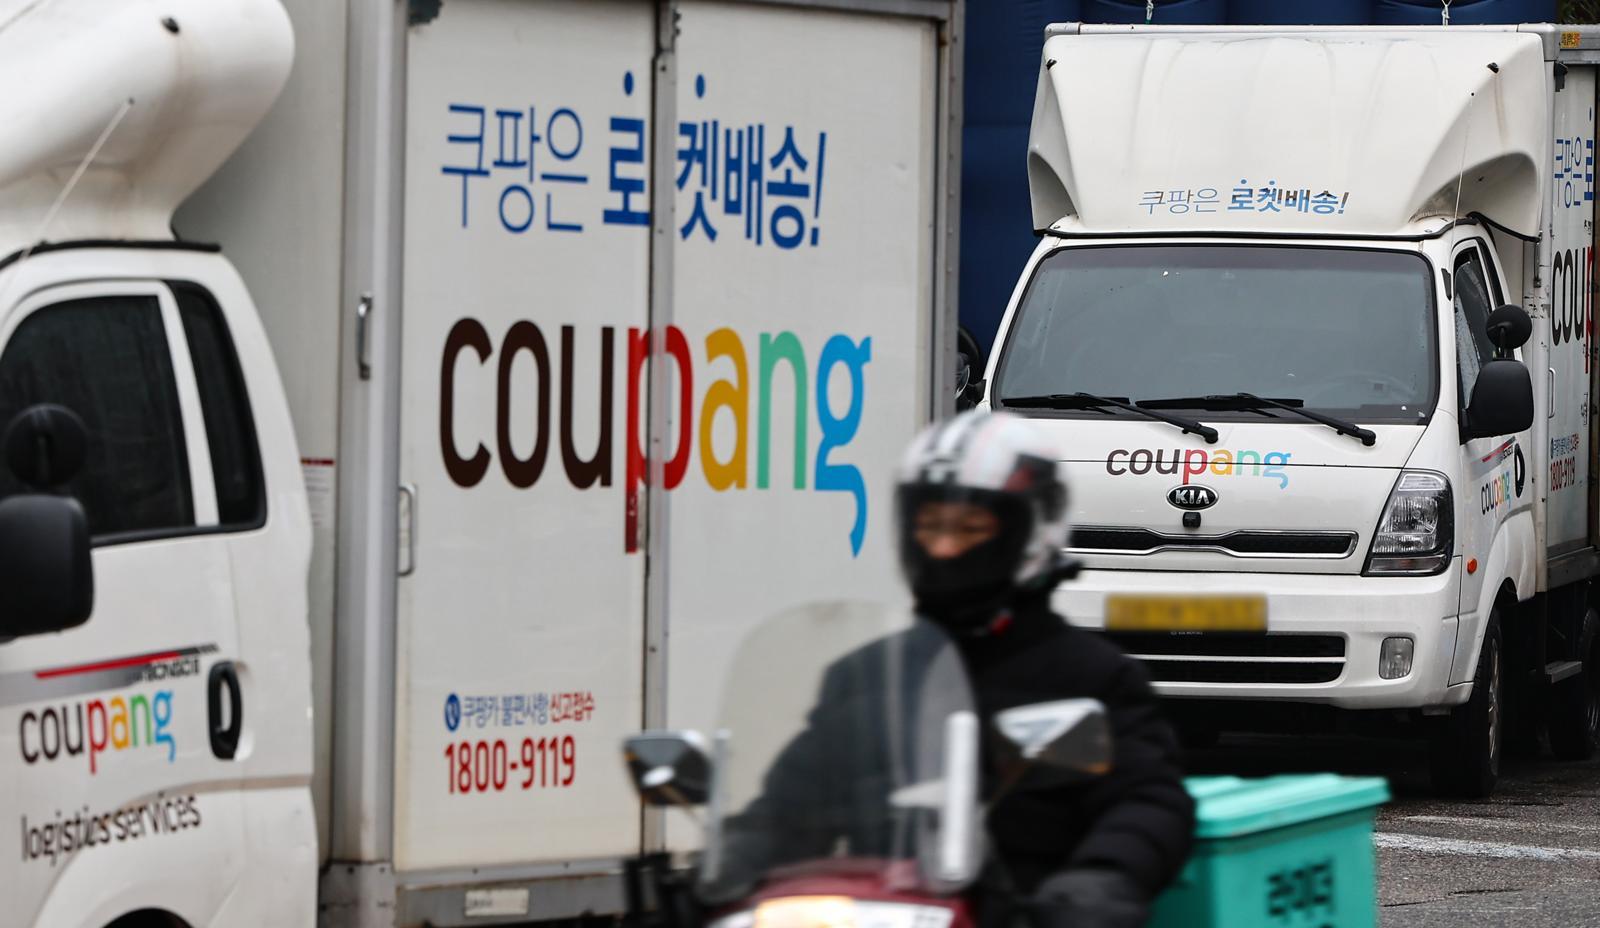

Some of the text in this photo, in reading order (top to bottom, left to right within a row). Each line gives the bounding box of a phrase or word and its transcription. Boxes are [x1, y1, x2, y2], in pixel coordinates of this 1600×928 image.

[442, 104, 826, 249] 쿠팡은 로켓배송!
[1138, 187, 1350, 214] 쿠팡은 로켓배송!
[1554, 136, 1582, 208] 쿠팡은
[440, 317, 872, 558] coupang
[1106, 449, 1292, 490] coupang
[1175, 489, 1210, 504] KIA
[1481, 471, 1511, 518] coupang
[1550, 456, 1575, 491] 1800-9119
[20, 689, 176, 775] coupang
[444, 735, 576, 795] 1800-9119
[20, 791, 202, 867] logistics services
